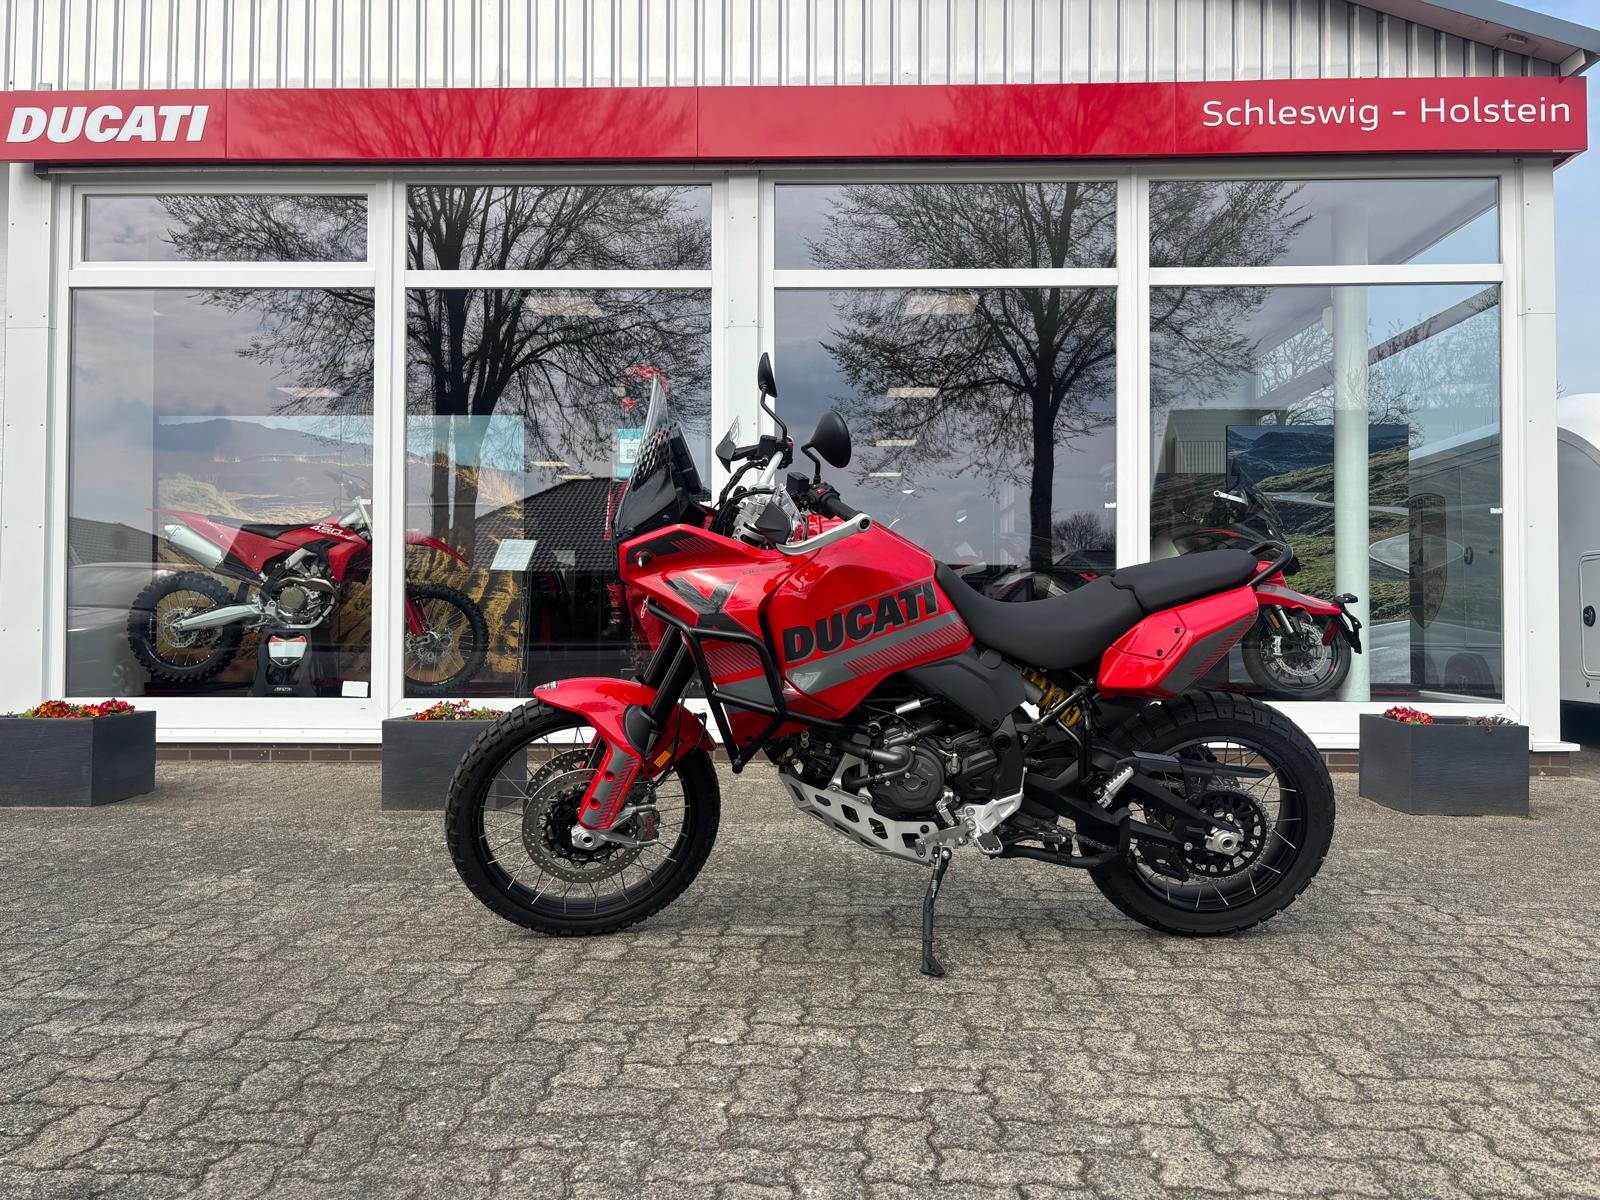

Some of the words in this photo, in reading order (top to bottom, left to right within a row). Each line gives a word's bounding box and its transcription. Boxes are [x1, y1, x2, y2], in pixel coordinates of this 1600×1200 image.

[6, 105, 209, 143] DUCATI
[1202, 98, 1379, 131] Schleswig
[1420, 96, 1571, 123] Holstein
[783, 581, 939, 663] DUCATI
